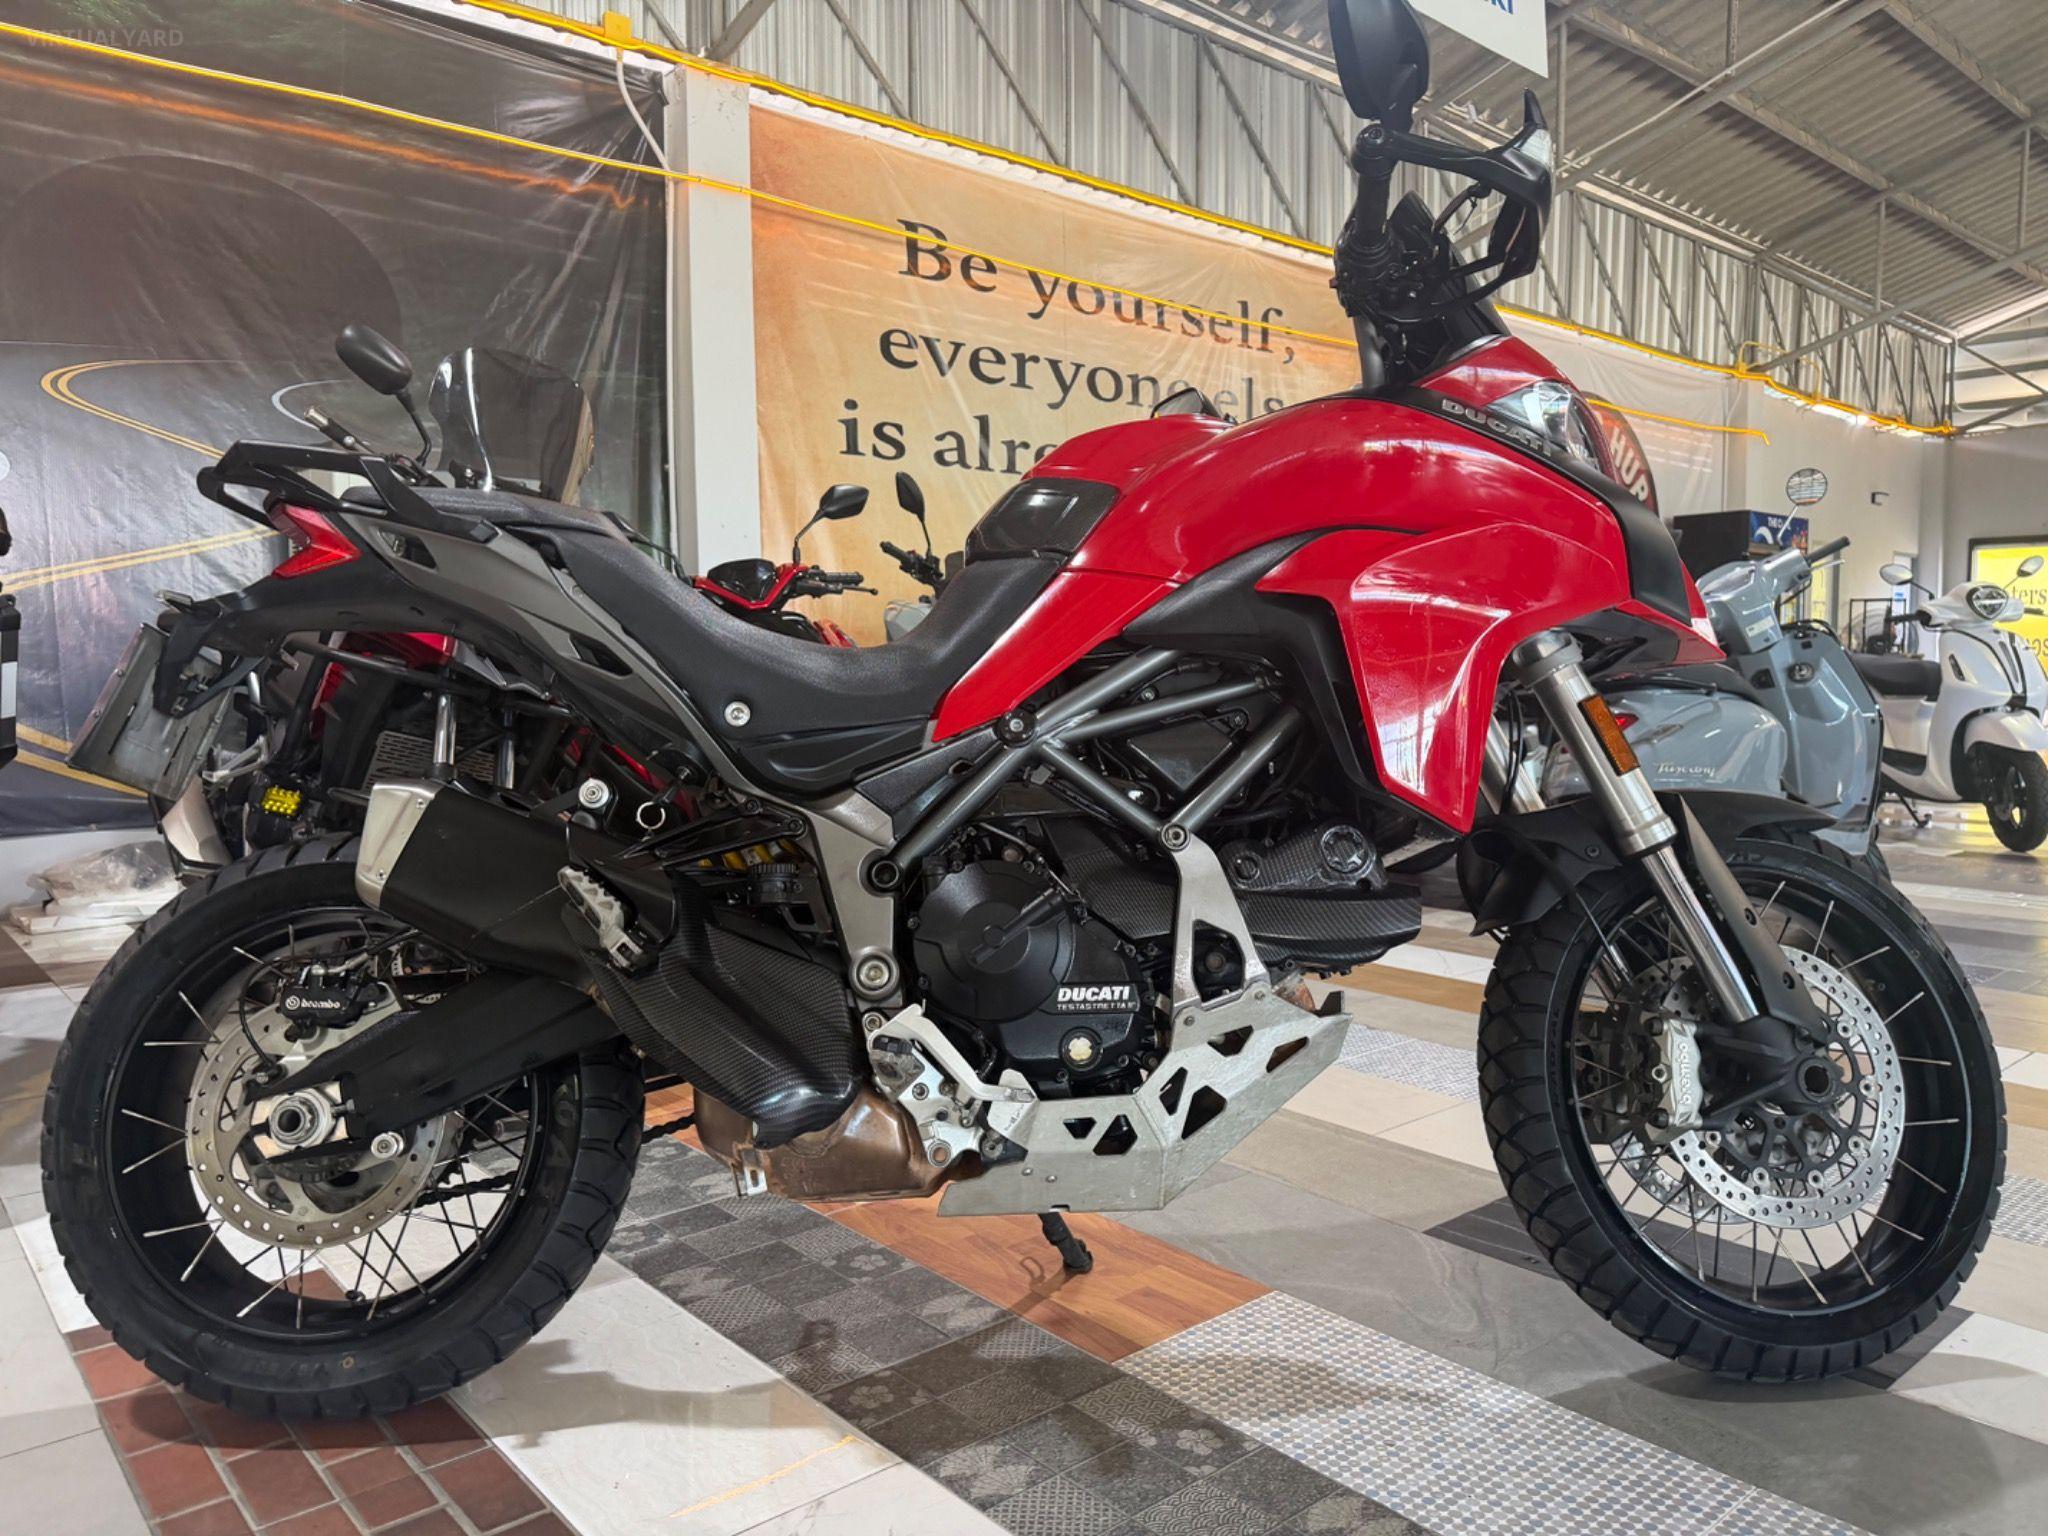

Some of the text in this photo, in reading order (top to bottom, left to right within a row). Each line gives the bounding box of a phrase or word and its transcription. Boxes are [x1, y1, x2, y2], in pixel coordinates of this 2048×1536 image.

[896, 219, 1295, 364] Be yourself;
[837, 398, 906, 461] is
[1441, 398, 1551, 457] DUCATI
[301, 998, 341, 1009] brembo
[1057, 986, 1130, 1002] DUCATI
[1679, 1042, 1692, 1105] brembo
